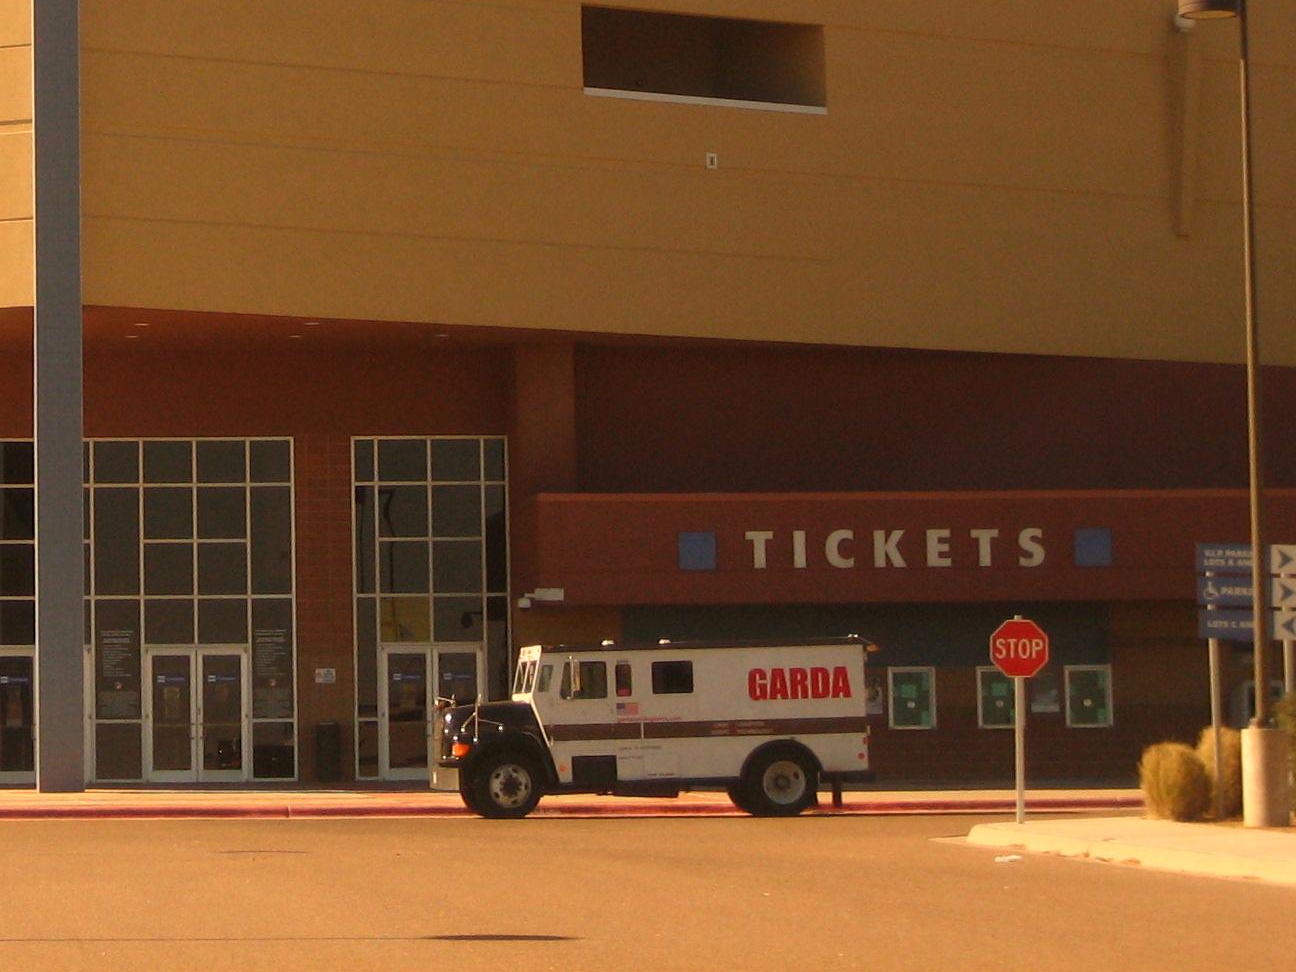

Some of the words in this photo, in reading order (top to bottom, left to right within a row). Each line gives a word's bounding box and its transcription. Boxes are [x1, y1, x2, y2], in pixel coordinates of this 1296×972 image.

[745, 528, 1045, 568] TICKETS
[995, 638, 1043, 659] STOP
[748, 666, 852, 701] GARDA
